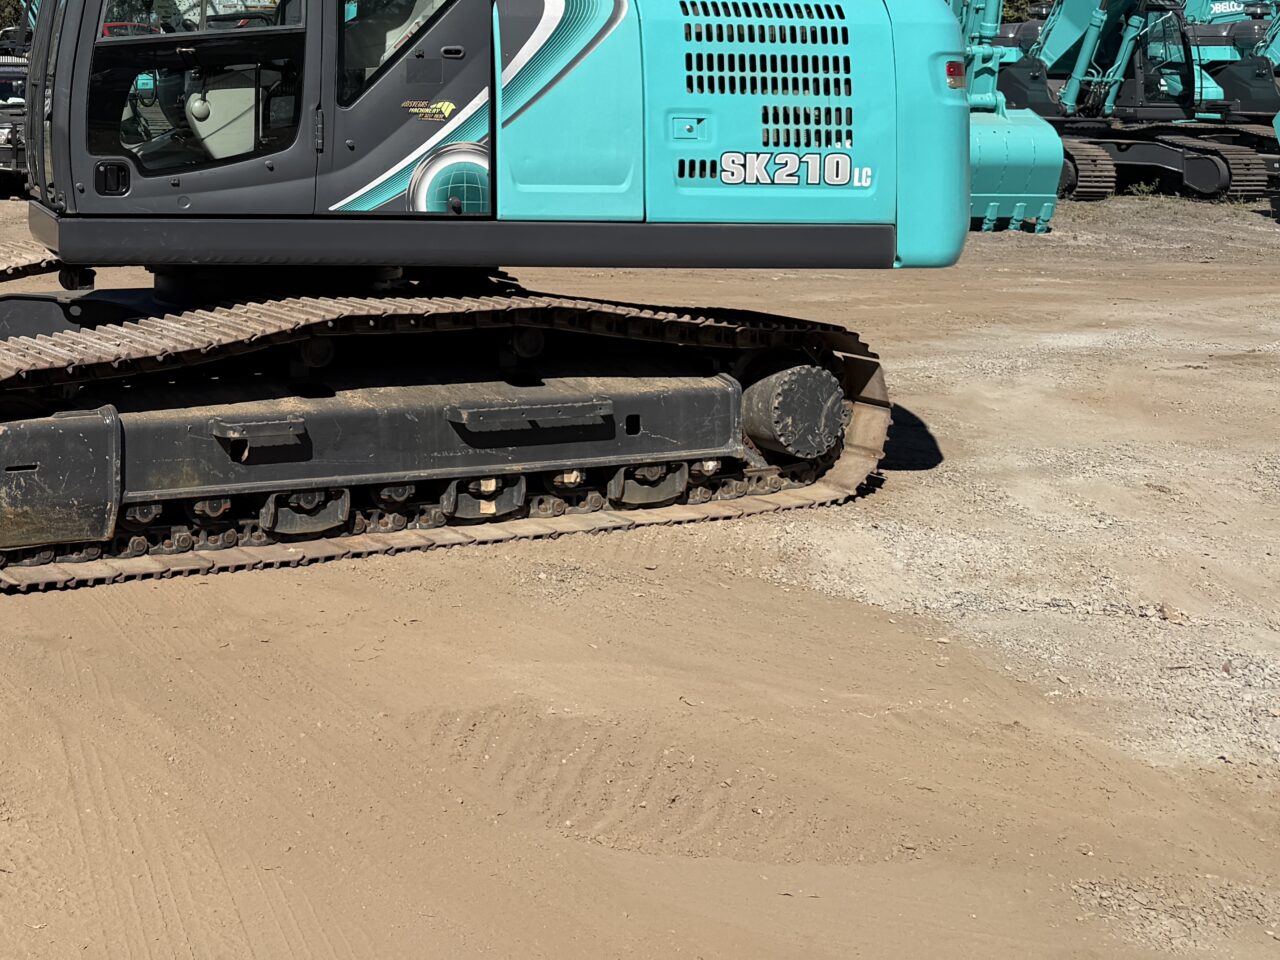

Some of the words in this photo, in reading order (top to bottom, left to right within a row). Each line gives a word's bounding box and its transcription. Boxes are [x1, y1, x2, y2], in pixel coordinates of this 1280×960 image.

[1210, 1, 1244, 14] OBELCO
[720, 151, 852, 186] SK210
[853, 167, 871, 187] LC
